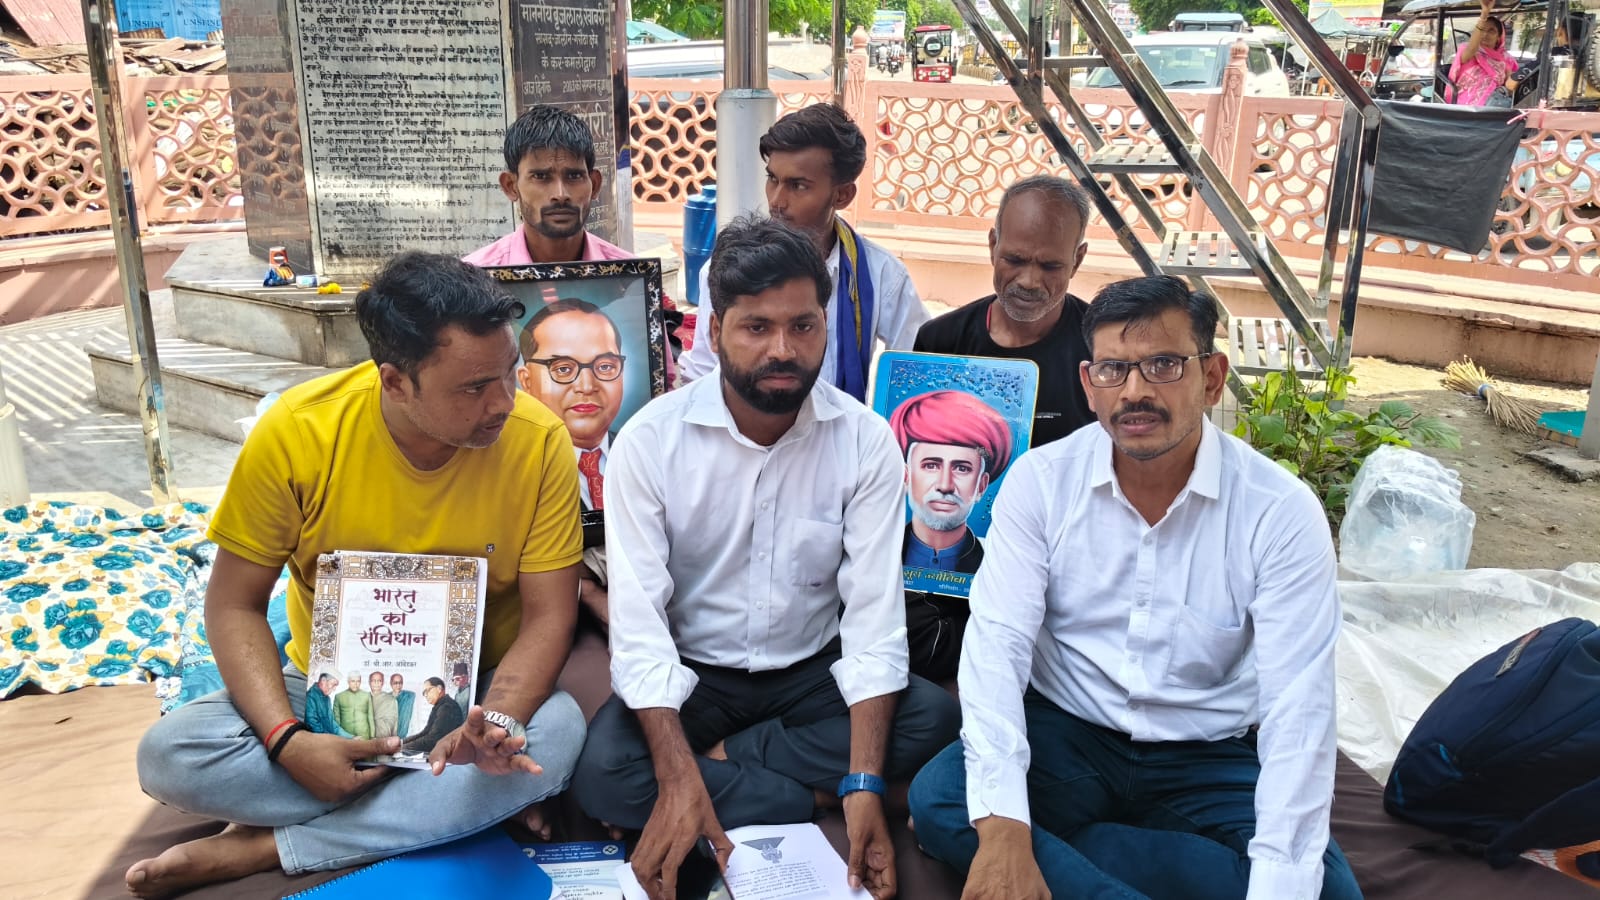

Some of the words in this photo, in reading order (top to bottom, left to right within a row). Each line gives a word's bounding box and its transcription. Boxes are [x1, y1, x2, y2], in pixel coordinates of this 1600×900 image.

[373, 588, 418, 613] भारत
[380, 612, 408, 626] का
[357, 625, 429, 653] संविधान
